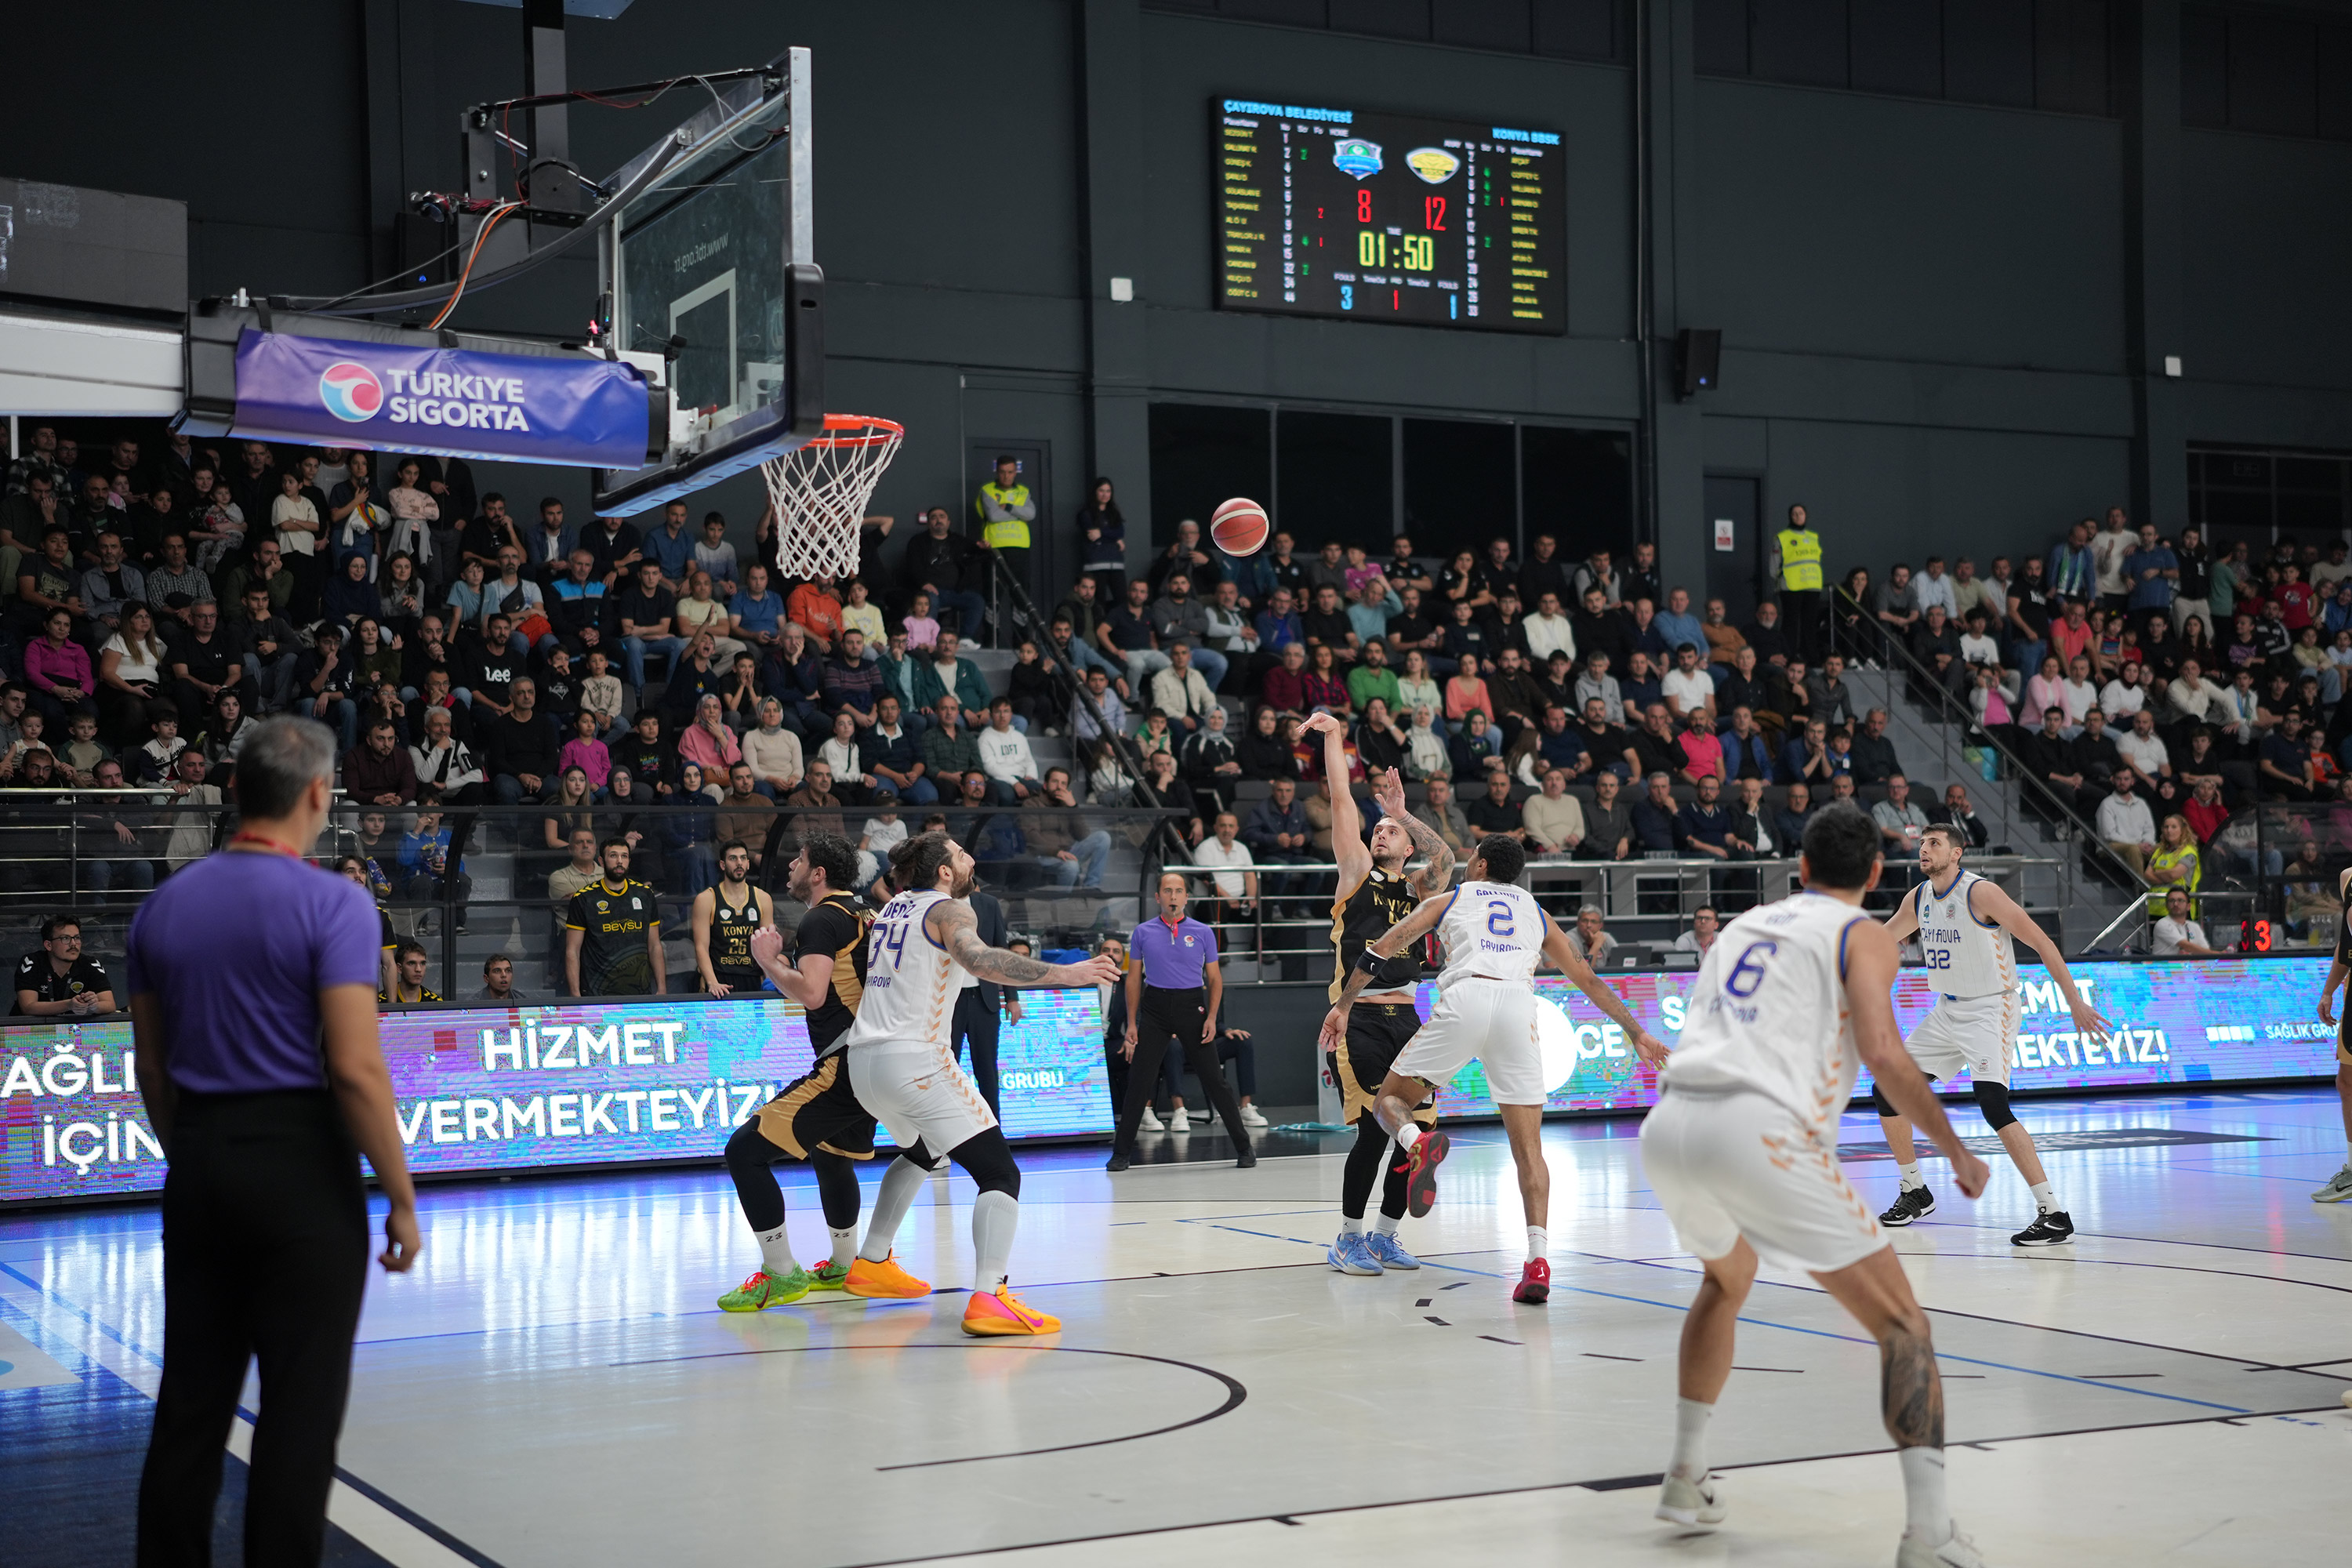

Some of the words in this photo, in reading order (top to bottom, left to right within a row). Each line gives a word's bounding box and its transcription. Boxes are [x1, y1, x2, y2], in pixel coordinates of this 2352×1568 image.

[1224, 100, 1283, 117] ÇAYIROVA
[1285, 106, 1352, 124] BELEDİYESİ
[1492, 128, 1530, 142] KONYA
[1284, 147, 1291, 158] 2
[1284, 176, 1291, 187] 5
[1284, 204, 1291, 216] 7
[1318, 208, 1323, 219] 2
[1358, 190, 1371, 223] 8
[1425, 196, 1446, 231] 12
[1500, 197, 1504, 206] 1
[1319, 237, 1323, 247] 1
[1359, 230, 1434, 272] 01:50
[1341, 285, 1353, 310] 3
[1393, 289, 1399, 310] 1
[1450, 293, 1457, 320] 1
[387, 369, 525, 403] TÜRKİYE
[389, 397, 530, 431] SİGORTA
[485, 666, 511, 684] Lee
[1000, 744, 1018, 756] LOFT
[1487, 899, 1516, 938] 2
[723, 926, 754, 937] KONYA
[2254, 920, 2271, 952] 3
[728, 938, 747, 955] 26
[867, 921, 912, 972] 34
[1480, 938, 1522, 953] ÇAYIRO
[1726, 941, 1777, 998] 6
[1926, 949, 1951, 970] 32
[2265, 1022, 2311, 1040] SAĞLIK
[2311, 1022, 2340, 1039] GRU
[482, 1018, 683, 1073] HİZMET
[2012, 1023, 2169, 1069] EKTEYİZ!
[0, 1044, 136, 1098] AĞLI
[1002, 1070, 1064, 1090] GRUBU
[43, 1112, 165, 1176] İÇİN
[765, 1232, 783, 1243] 23
